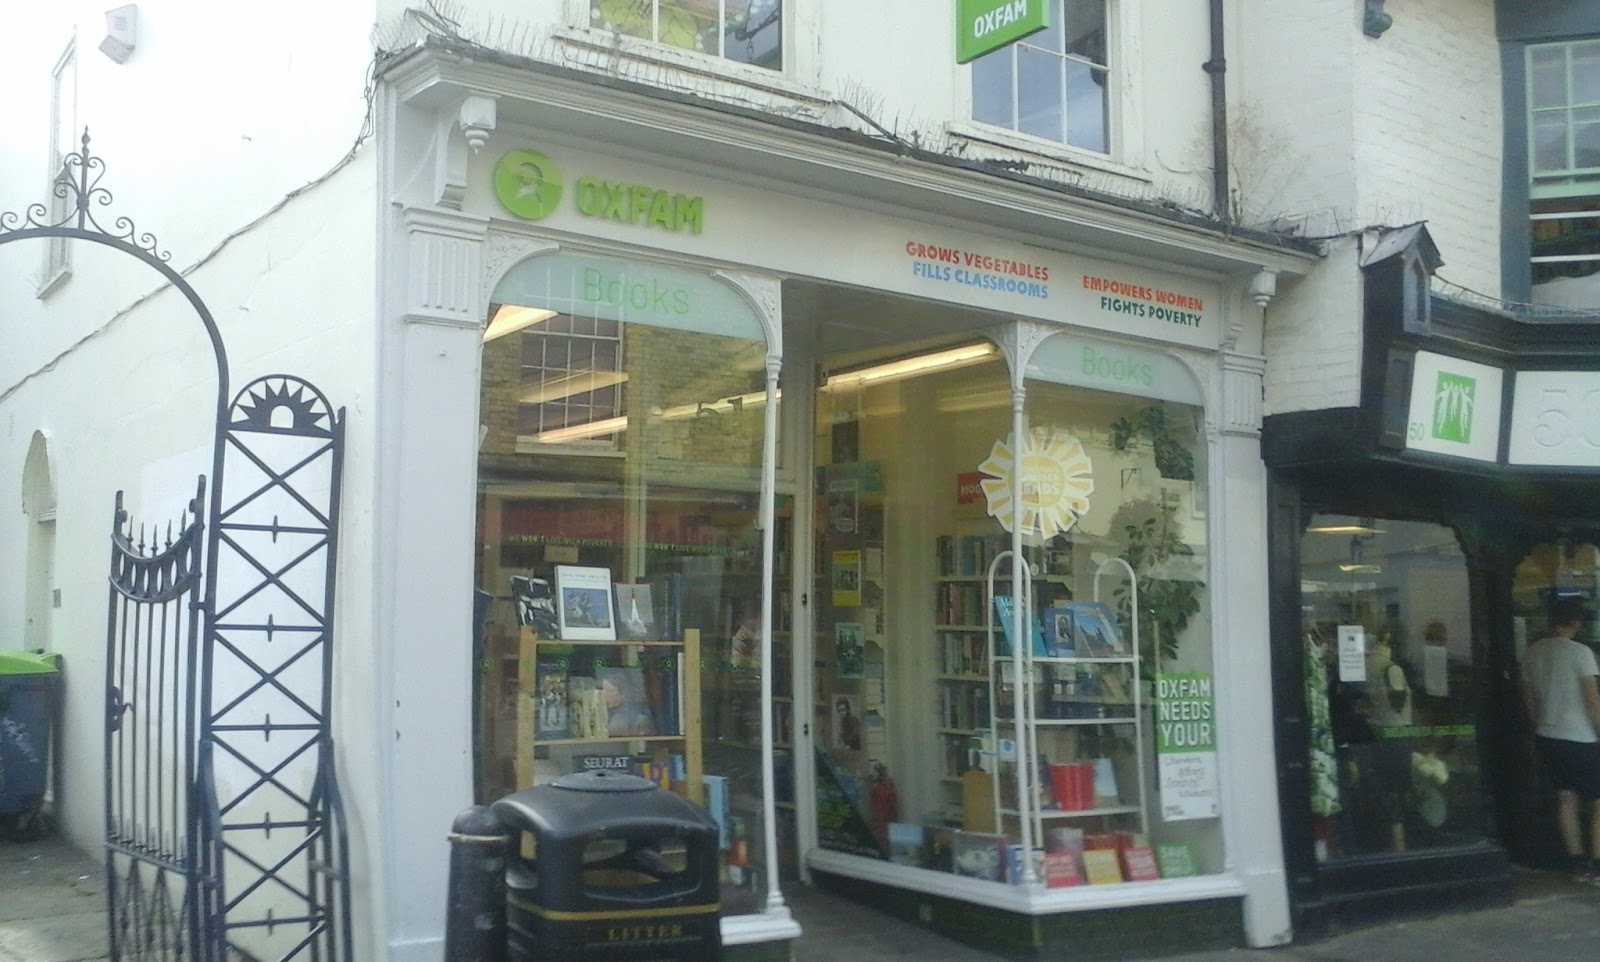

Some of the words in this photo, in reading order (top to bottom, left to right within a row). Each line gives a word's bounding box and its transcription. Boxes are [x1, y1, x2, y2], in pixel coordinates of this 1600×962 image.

[974, 0, 1027, 38] OXFAM
[576, 176, 703, 235] OXFAM
[906, 241, 960, 265] GROWS
[963, 252, 1049, 282] VEGETABLES
[913, 261, 951, 282] FILLS
[954, 269, 1049, 299] CLASSROOMS
[583, 267, 690, 315] Books
[1083, 275, 1152, 302] EMPOWERS
[1156, 290, 1203, 312] WOMEN
[1101, 296, 1145, 317] FIGHTS
[1149, 306, 1202, 328] POVERTY
[1082, 345, 1154, 388] Books
[1408, 422, 1425, 441] 50
[1159, 679, 1212, 699] OXFAM
[1160, 700, 1212, 721] NEEDS
[1160, 722, 1212, 747] YOUR
[583, 756, 629, 769] SEURAT
